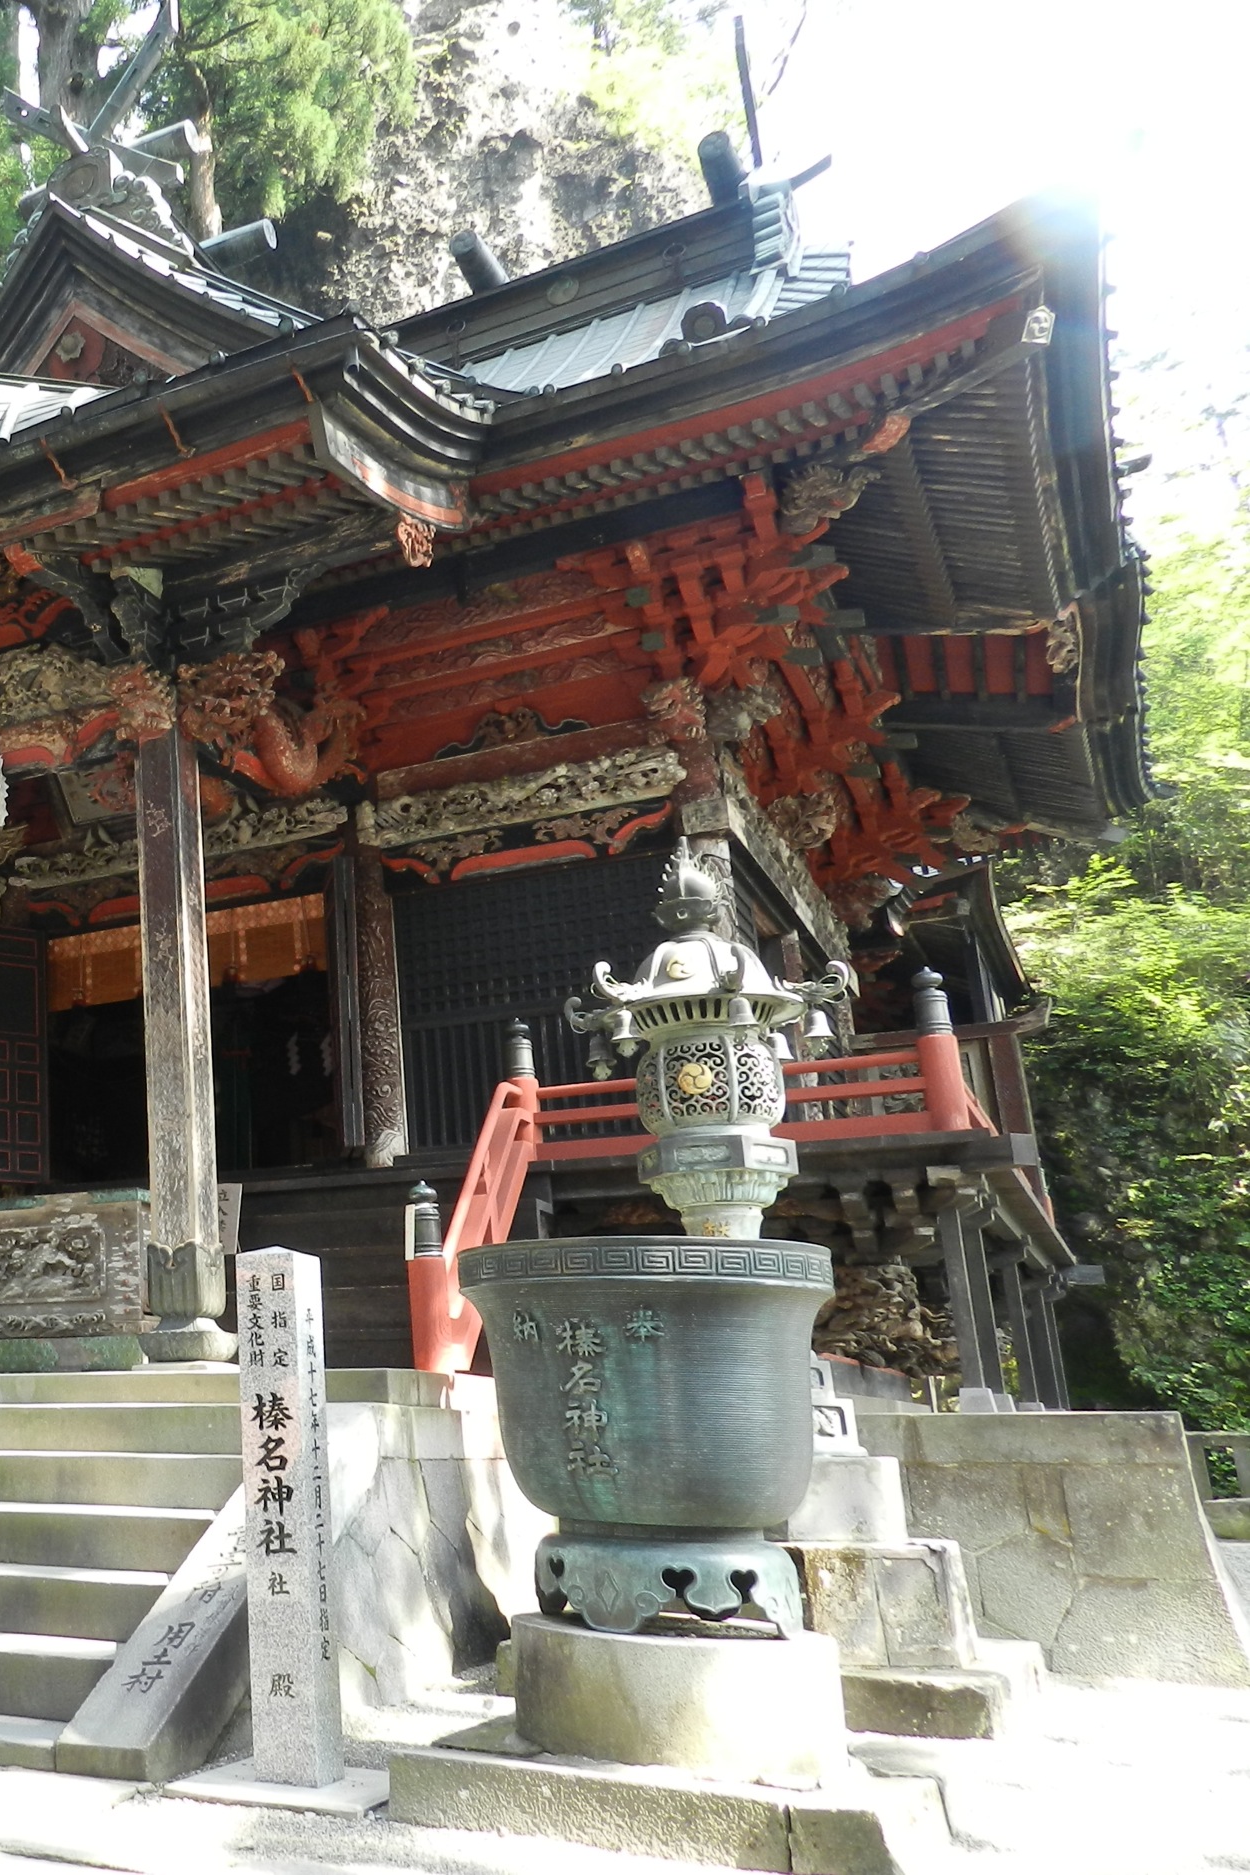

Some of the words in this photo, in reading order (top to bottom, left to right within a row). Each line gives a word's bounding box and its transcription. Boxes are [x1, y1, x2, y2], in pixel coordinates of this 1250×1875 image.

[246, 1274, 266, 1367] 重要文化財
[271, 1273, 289, 1367] 国指定
[556, 1319, 619, 1475] 榛名神社
[250, 1391, 297, 1557] 榛名神社
[121, 1621, 196, 1694] 用土村
